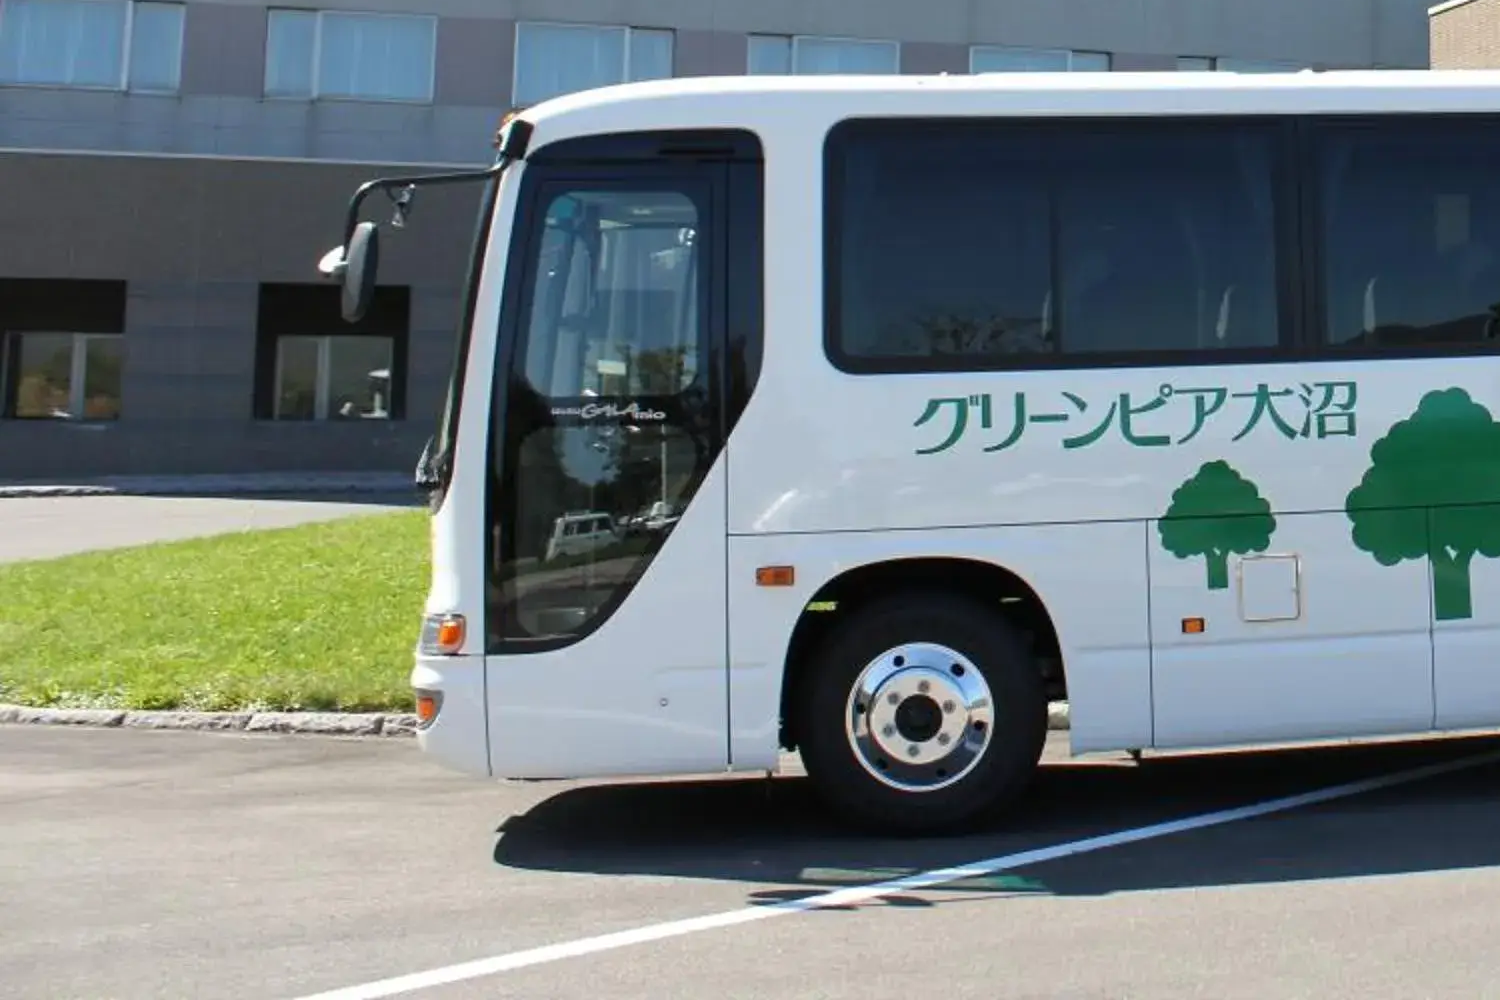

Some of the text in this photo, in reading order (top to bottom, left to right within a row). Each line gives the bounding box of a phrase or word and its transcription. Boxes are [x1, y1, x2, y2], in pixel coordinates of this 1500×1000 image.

[913, 381, 1357, 455] グリーンピア大沼
